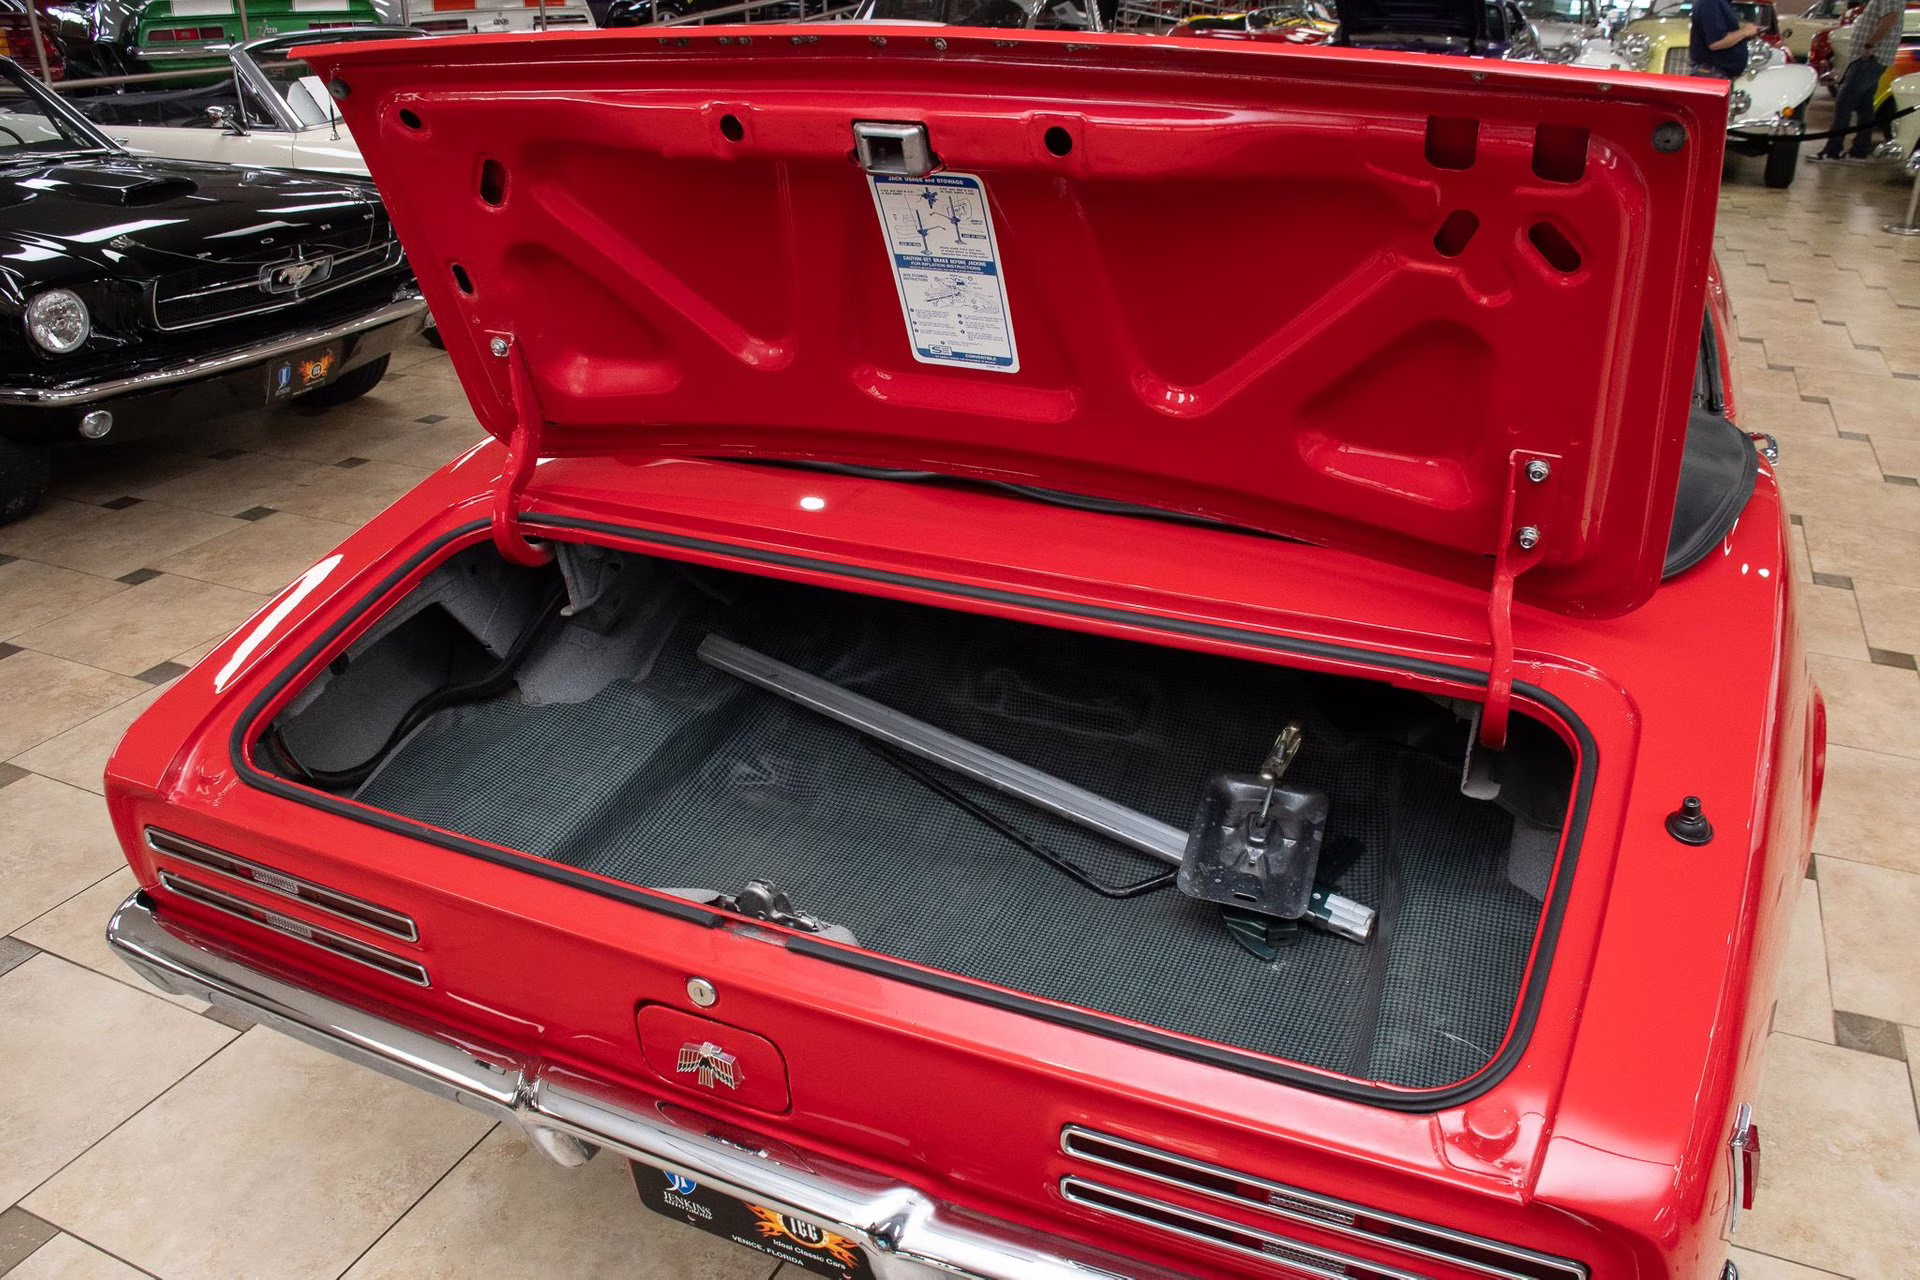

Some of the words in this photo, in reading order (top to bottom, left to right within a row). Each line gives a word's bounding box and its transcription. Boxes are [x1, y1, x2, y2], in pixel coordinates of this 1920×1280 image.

[663, 1191, 713, 1217] JENKINS
[731, 1234, 766, 1252] VENICE,
[766, 1247, 804, 1266] FLORIDA
[773, 1239, 793, 1251] Ideal
[794, 1246, 825, 1262] Classic
[825, 1257, 847, 1270] Cars
